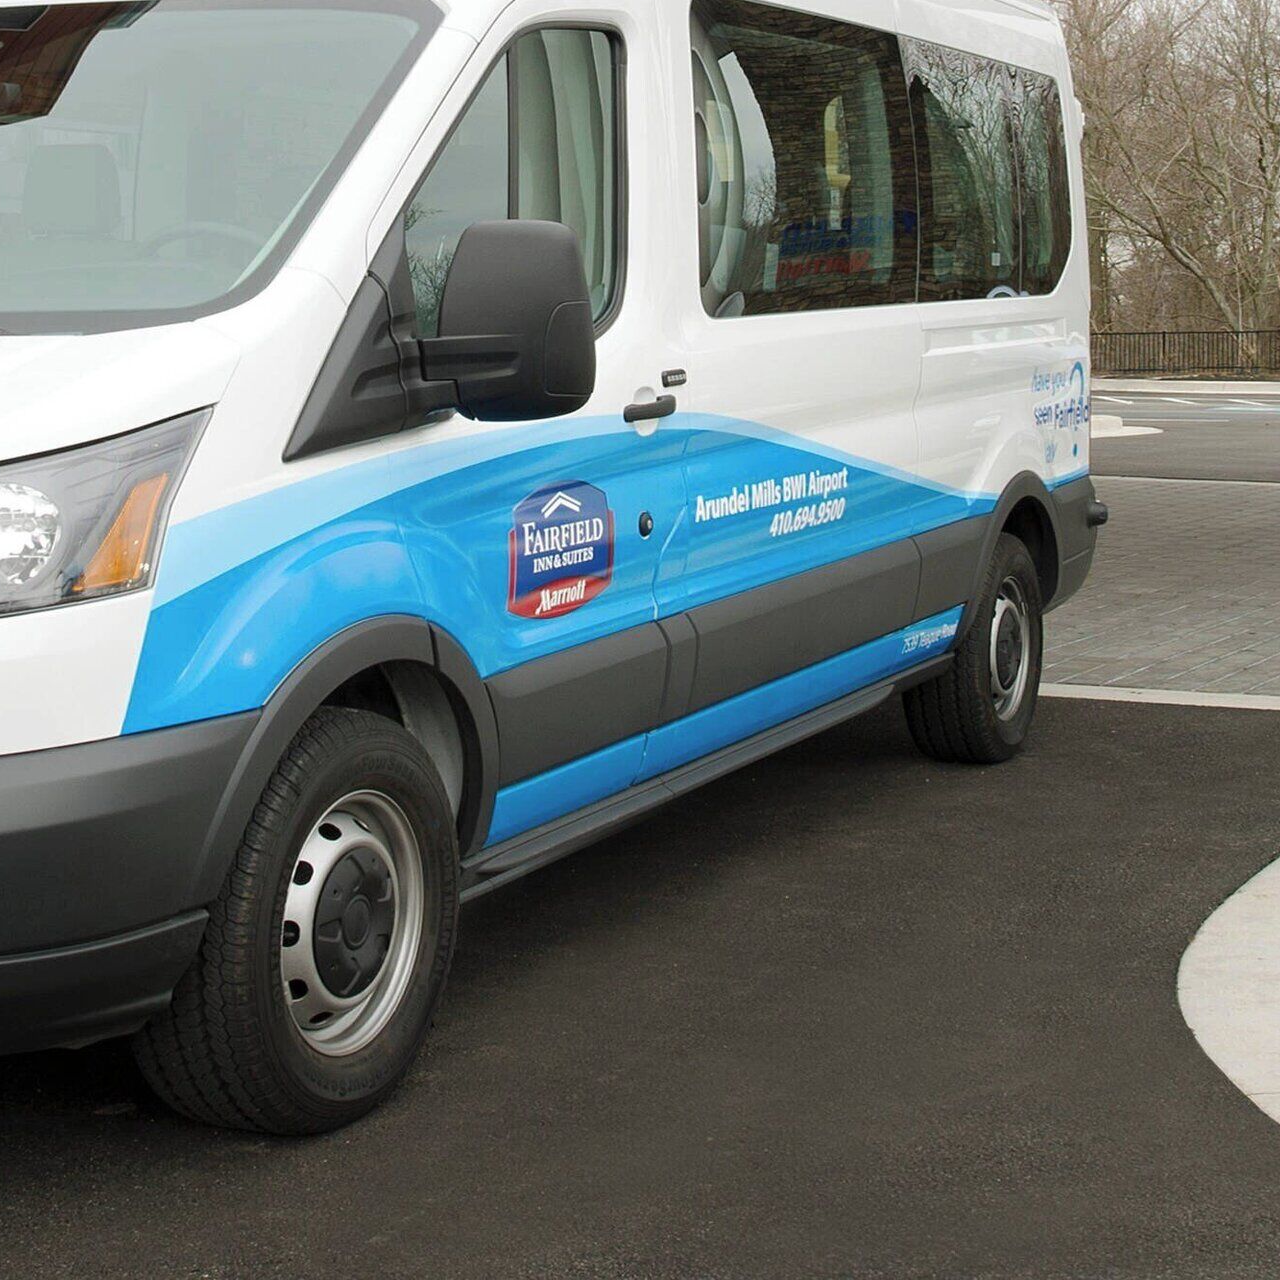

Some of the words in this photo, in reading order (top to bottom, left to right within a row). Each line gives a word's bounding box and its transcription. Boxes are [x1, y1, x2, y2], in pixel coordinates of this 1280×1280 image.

[695, 484, 750, 523] Arundel
[752, 479, 782, 509] Mills
[783, 473, 807, 503] BWI
[808, 467, 848, 499] Airport
[522, 517, 604, 556] FAIRFIELD
[770, 497, 846, 537] 410.694.9500
[535, 579, 586, 615] Marriott
